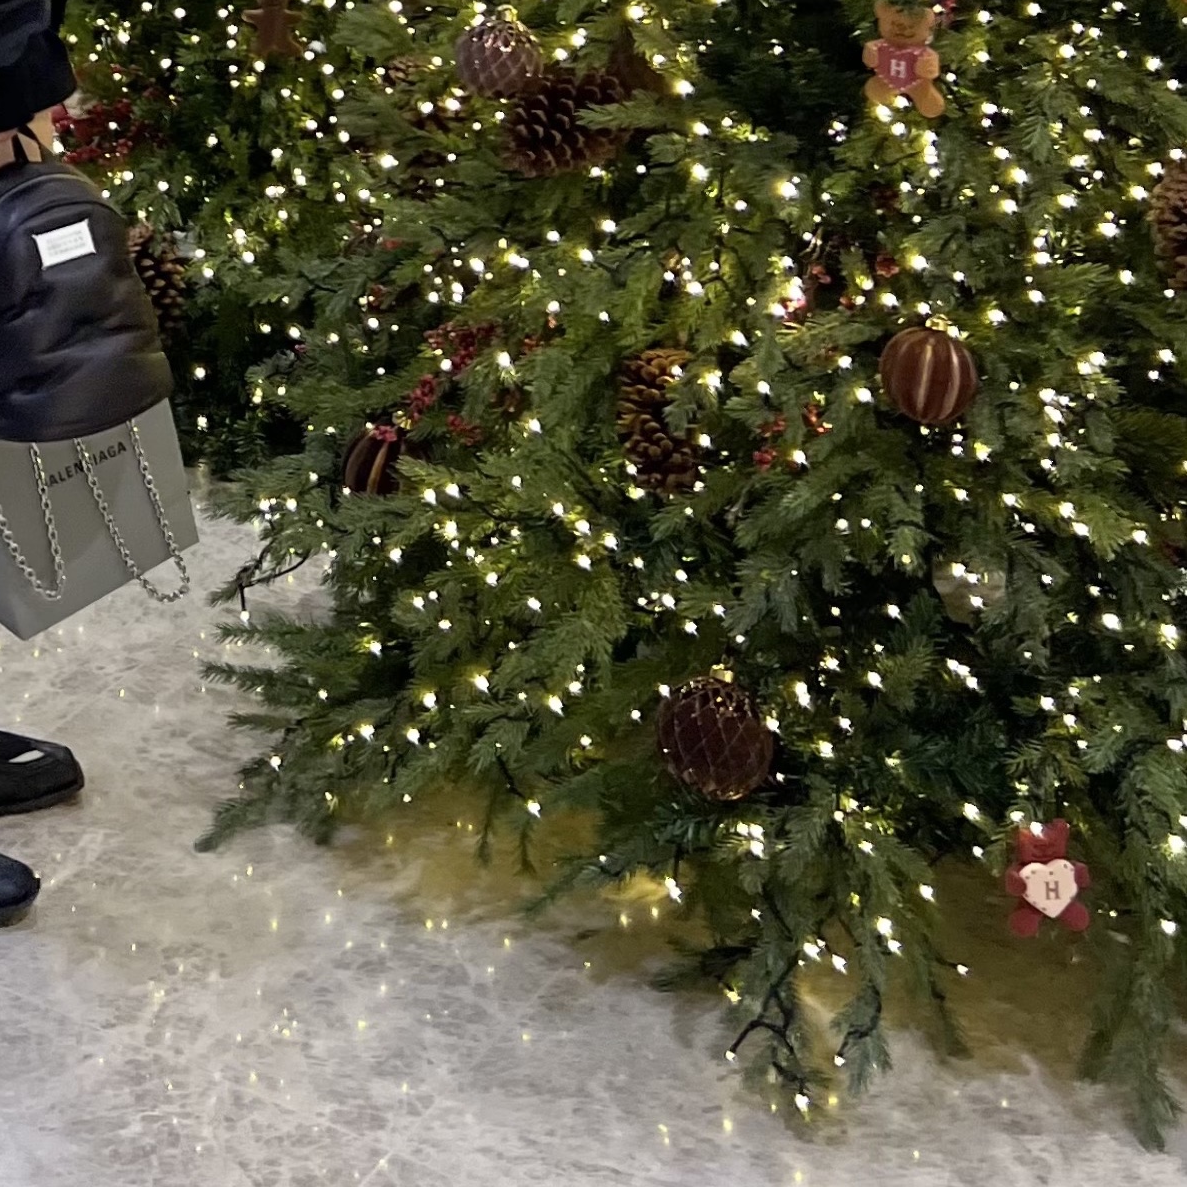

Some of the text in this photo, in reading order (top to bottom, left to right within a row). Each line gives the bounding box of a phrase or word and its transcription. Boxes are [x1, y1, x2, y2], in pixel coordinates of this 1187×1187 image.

[890, 59, 906, 78] H
[44, 441, 127, 488] ALENIAGA
[1044, 880, 1061, 900] H
